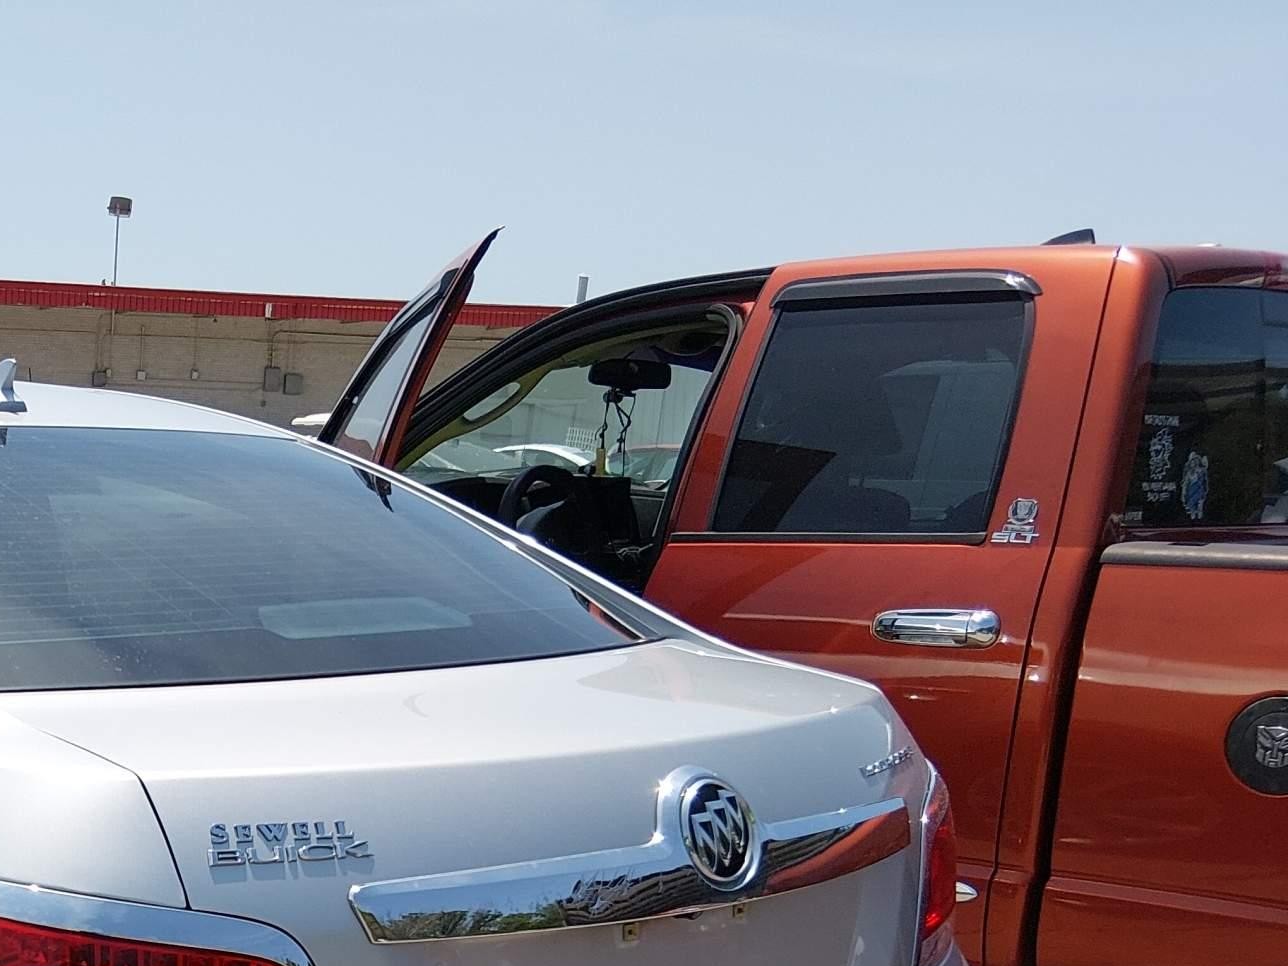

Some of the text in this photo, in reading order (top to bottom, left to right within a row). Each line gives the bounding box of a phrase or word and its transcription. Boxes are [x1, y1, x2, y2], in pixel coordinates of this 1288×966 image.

[990, 531, 1040, 544] SLT
[210, 820, 354, 843] SEWELL
[207, 840, 375, 867] BUICK
